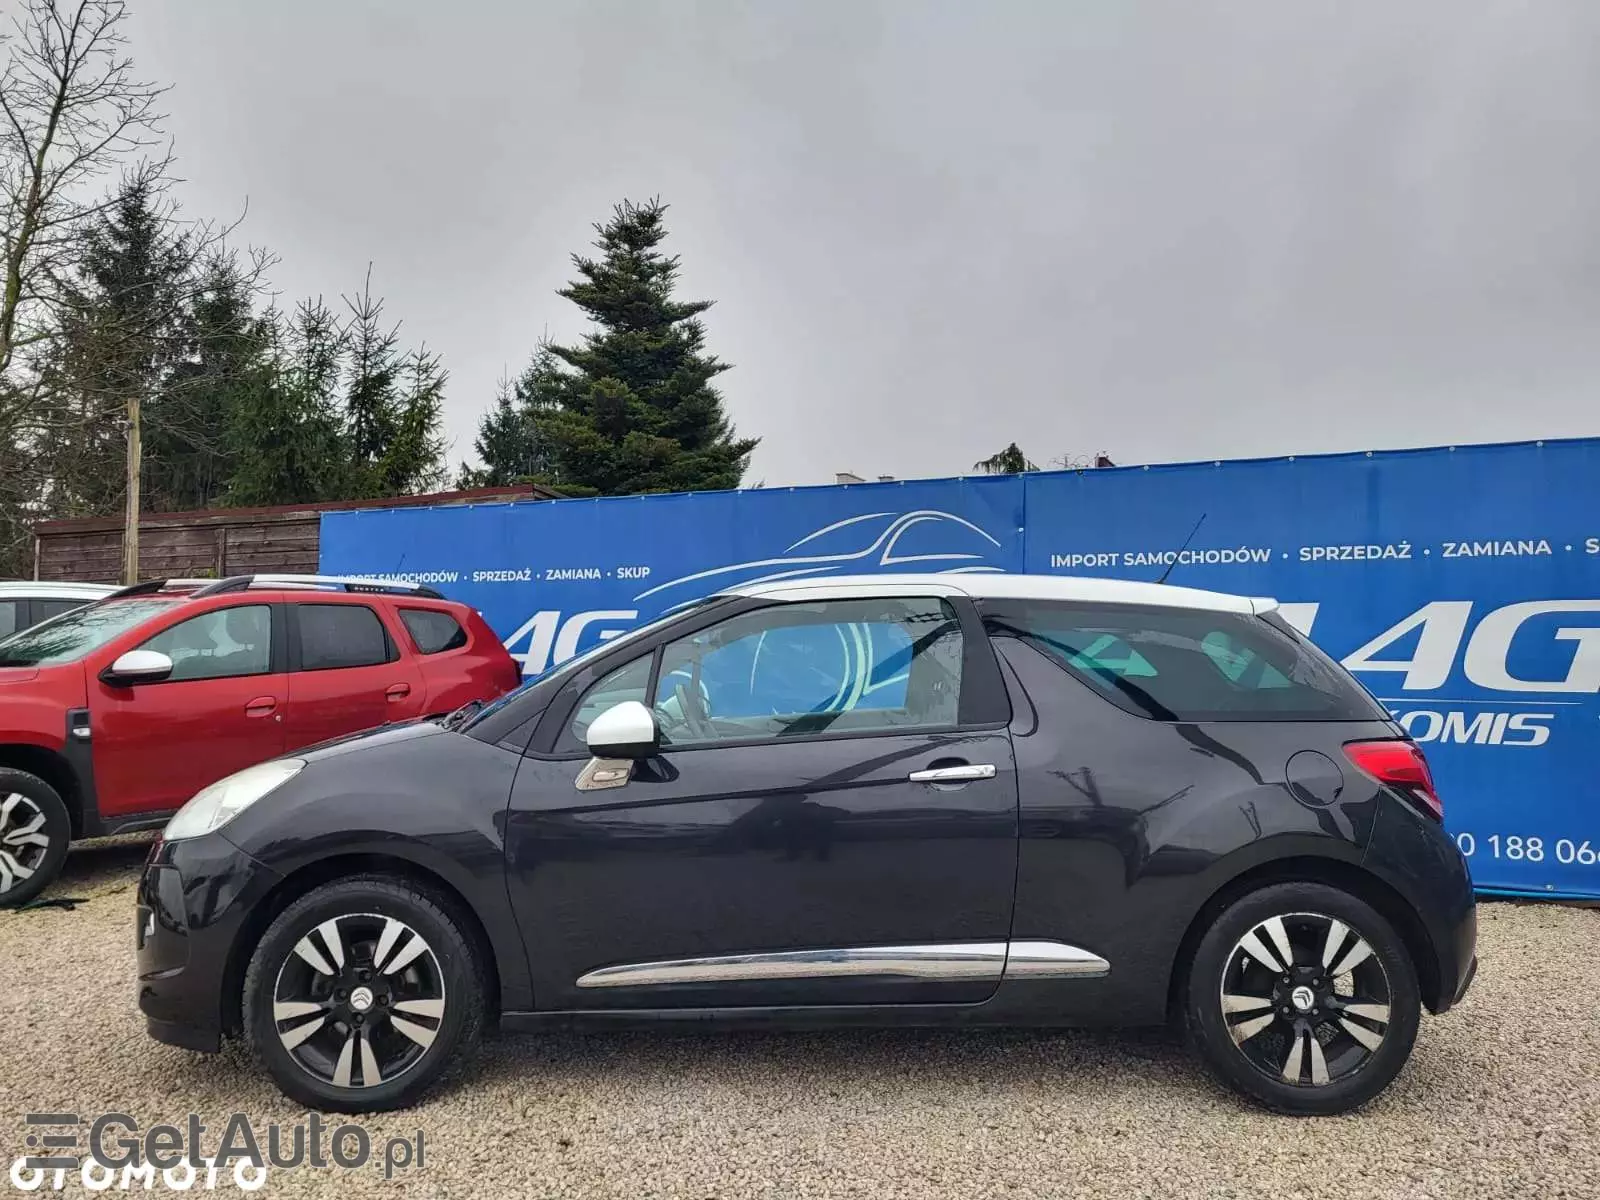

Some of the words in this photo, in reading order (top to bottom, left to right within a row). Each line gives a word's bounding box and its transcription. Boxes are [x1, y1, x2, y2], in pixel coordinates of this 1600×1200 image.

[1051, 552, 1119, 567] IMPORT
[1123, 546, 1272, 566] SAMOCHODÓW
[1299, 540, 1412, 561] SPRZEDAŻ
[1442, 540, 1552, 558] ZAMIANA
[472, 567, 532, 582] SPRZEDAŻ
[545, 568, 602, 581] ZAMIANA
[616, 566, 650, 579] SKUP
[1389, 709, 1555, 746] OMIS
[1449, 832, 1475, 857] 0
[1487, 834, 1545, 862] 188
[1555, 839, 1600, 865] 06
